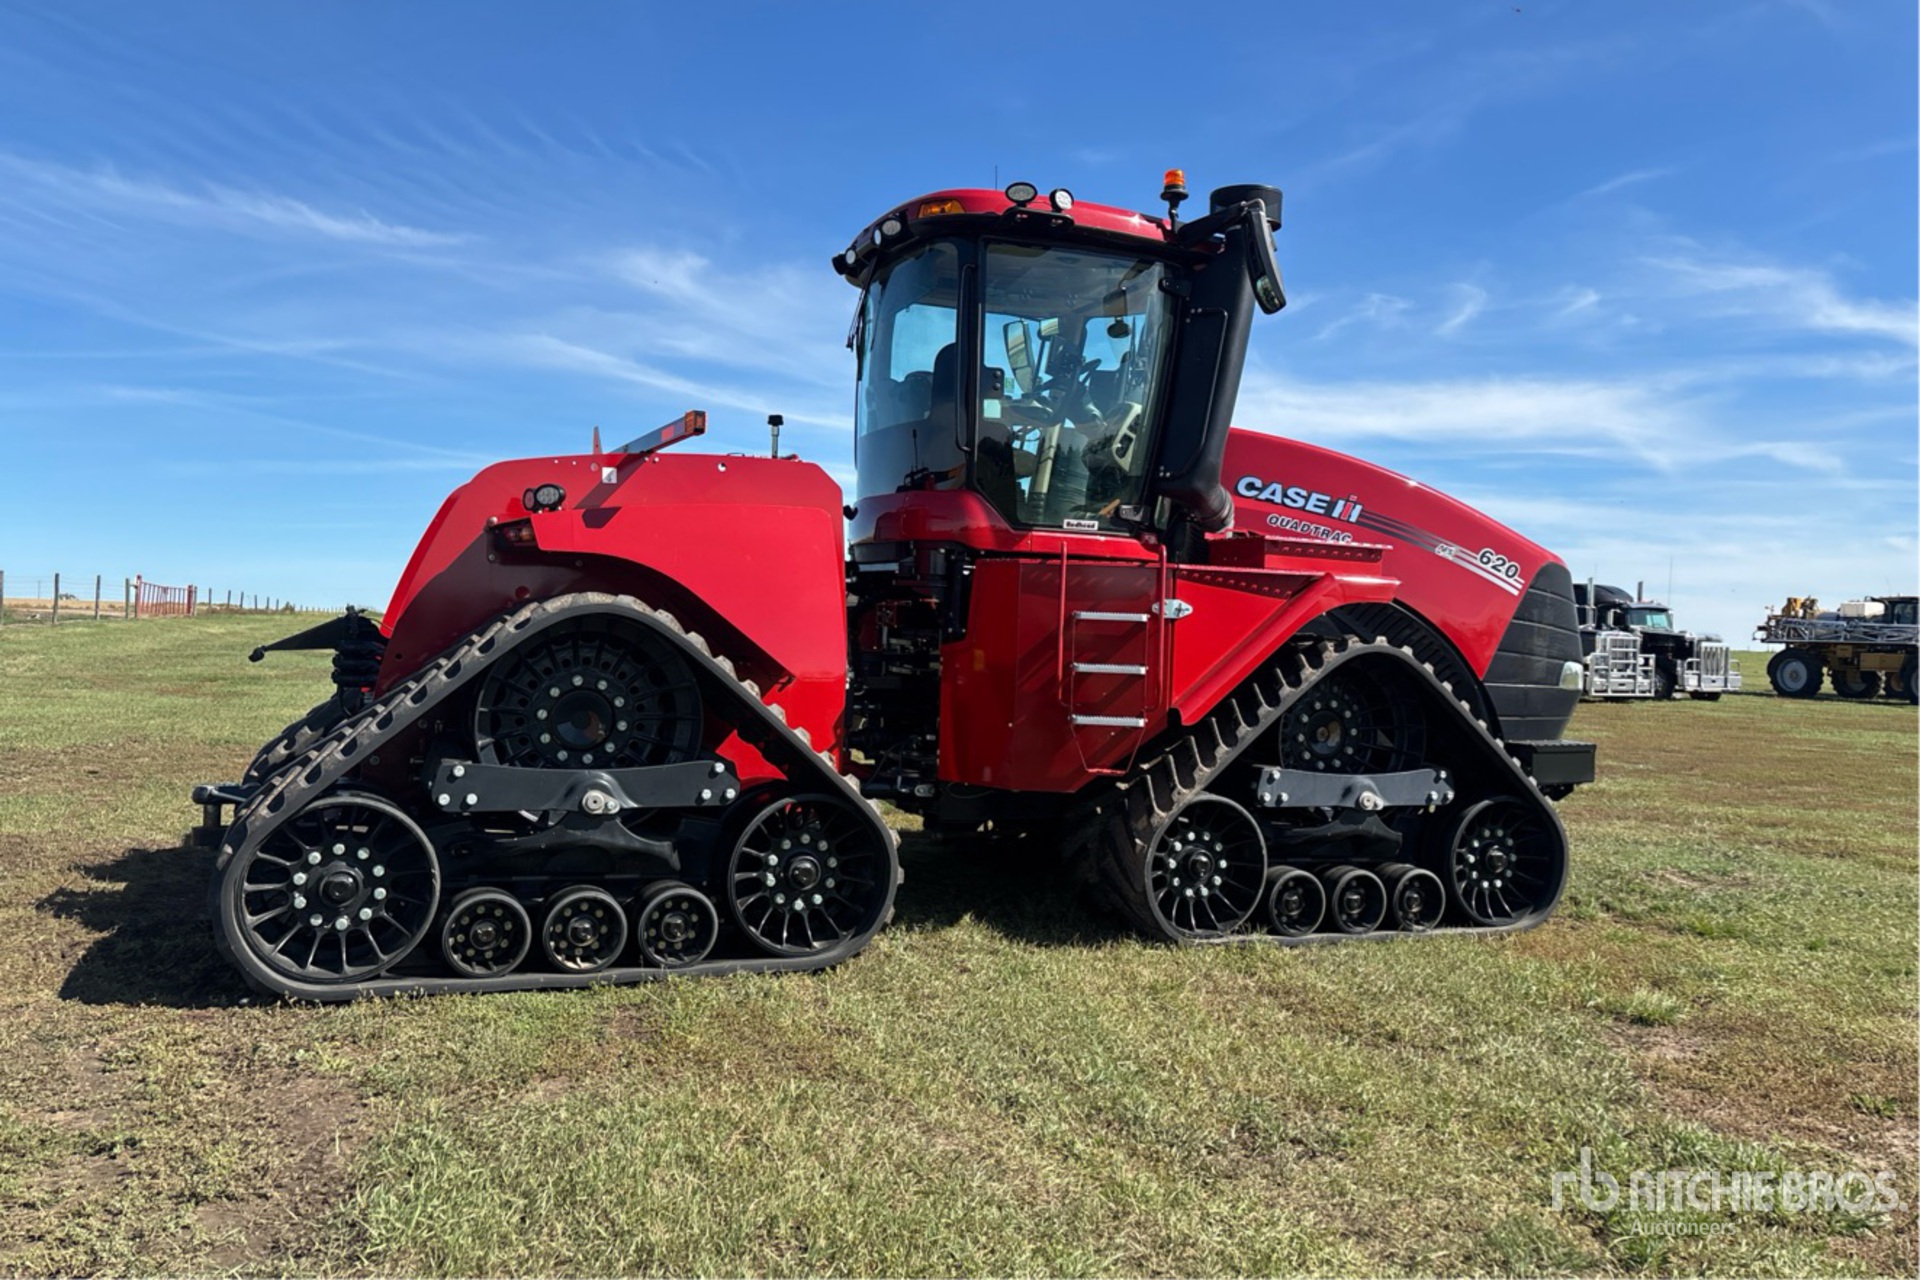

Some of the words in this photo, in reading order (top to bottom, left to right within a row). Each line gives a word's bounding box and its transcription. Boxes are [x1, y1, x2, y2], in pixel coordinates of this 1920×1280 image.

[1236, 475, 1331, 515] CASE
[1267, 514, 1353, 542] QUADTRAC
[1479, 549, 1519, 579] 620
